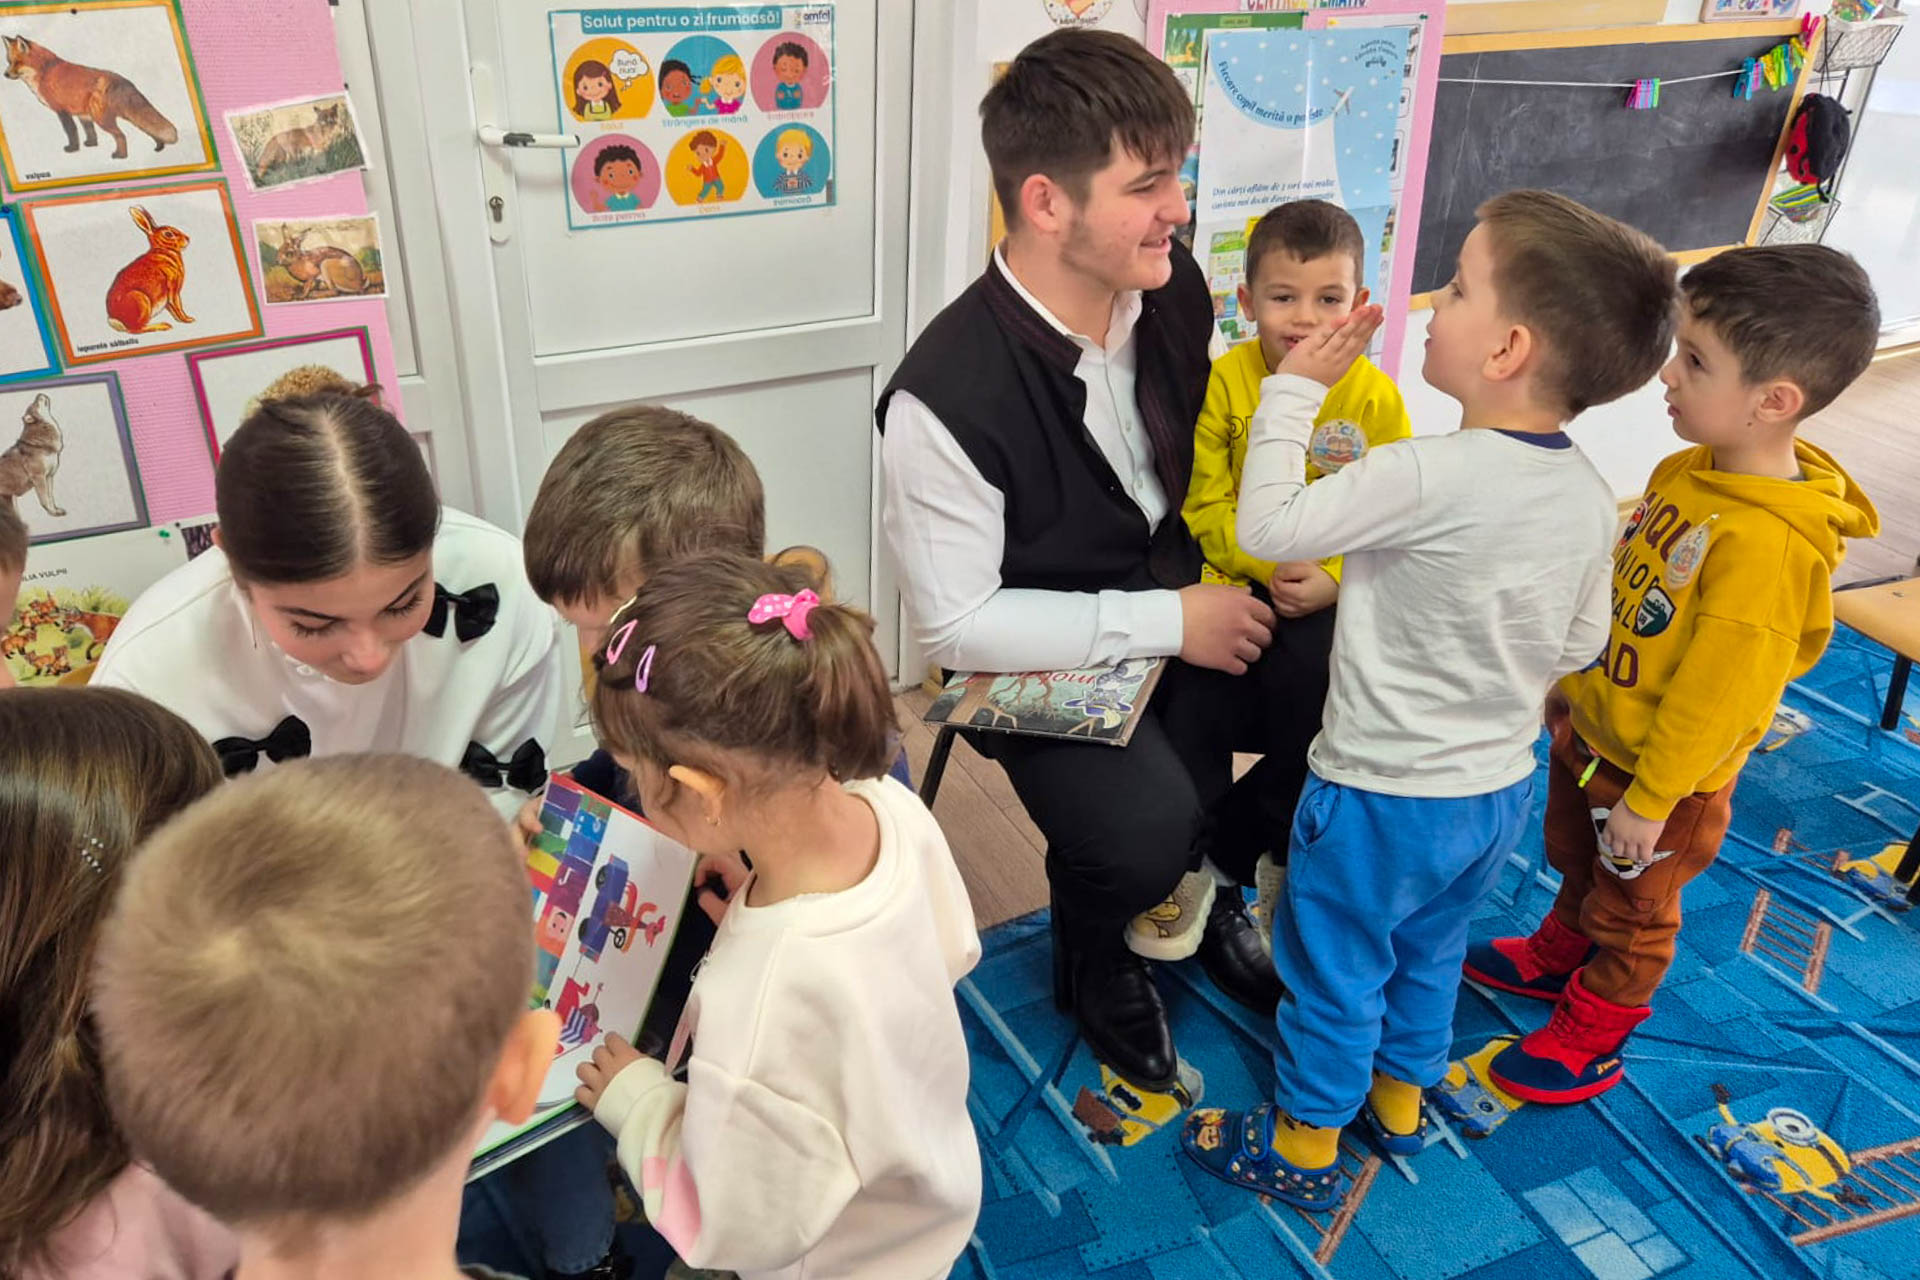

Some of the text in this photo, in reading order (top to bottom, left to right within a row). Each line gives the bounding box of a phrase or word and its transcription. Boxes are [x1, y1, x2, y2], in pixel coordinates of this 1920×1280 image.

[583, 9, 780, 31] Salut pentru o zi frumoasă!
[1235, 92, 1258, 112] copil
[1255, 107, 1286, 122] merită
